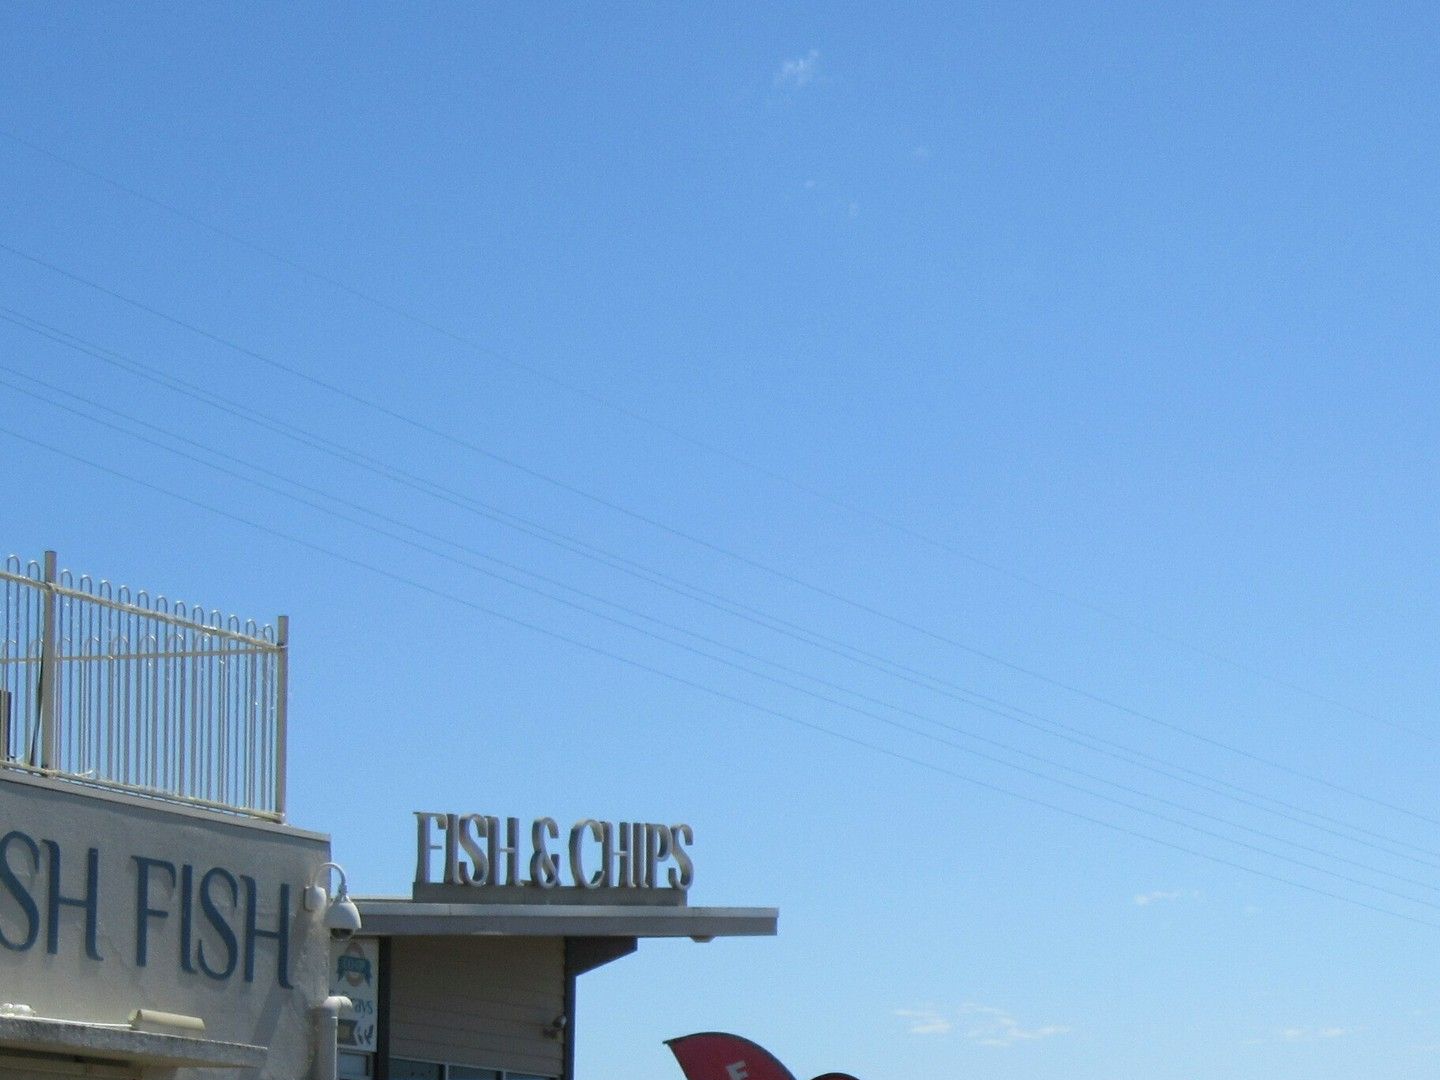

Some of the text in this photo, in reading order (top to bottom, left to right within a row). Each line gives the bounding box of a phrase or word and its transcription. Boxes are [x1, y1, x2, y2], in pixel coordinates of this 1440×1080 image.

[413, 811, 695, 890] FISH & CHIPS
[131, 855, 295, 989] FISH
